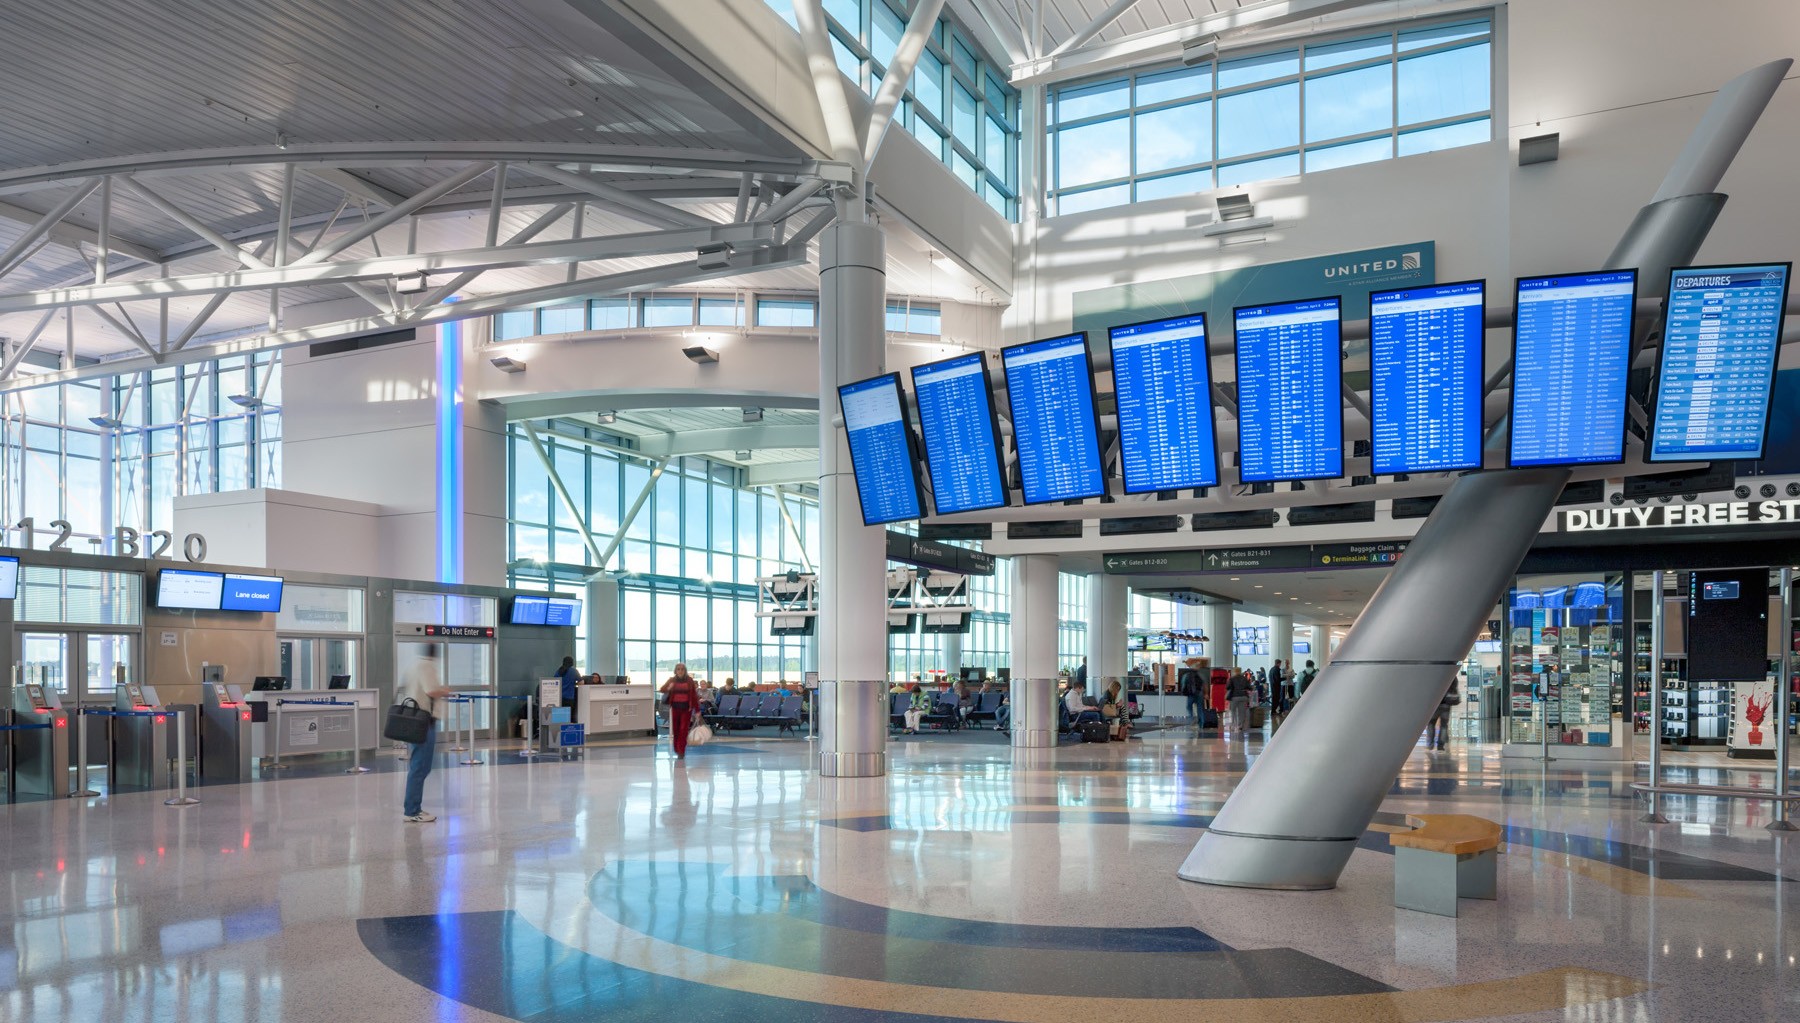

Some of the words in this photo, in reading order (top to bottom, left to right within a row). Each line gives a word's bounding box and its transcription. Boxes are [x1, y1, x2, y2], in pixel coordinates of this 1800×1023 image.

[1324, 259, 1398, 278] UNITED
[1676, 276, 1731, 288] DEPARTURES
[1566, 507, 1655, 532] DUTY
[1664, 501, 1749, 526] FREE
[1231, 550, 1246, 558] Gates
[1247, 549, 1271, 557] B21-B31
[1350, 545, 1376, 553] Baggage
[1144, 558, 1168, 566] B12-B20
[1372, 554, 1378, 562] A
[1390, 553, 1396, 561] D
[1231, 559, 1259, 567] Restrooms
[235, 590, 250, 599] Lane
[250, 591, 270, 600] closed
[441, 627, 451, 635] Do
[451, 627, 463, 635] Not
[463, 628, 480, 636] Enter
